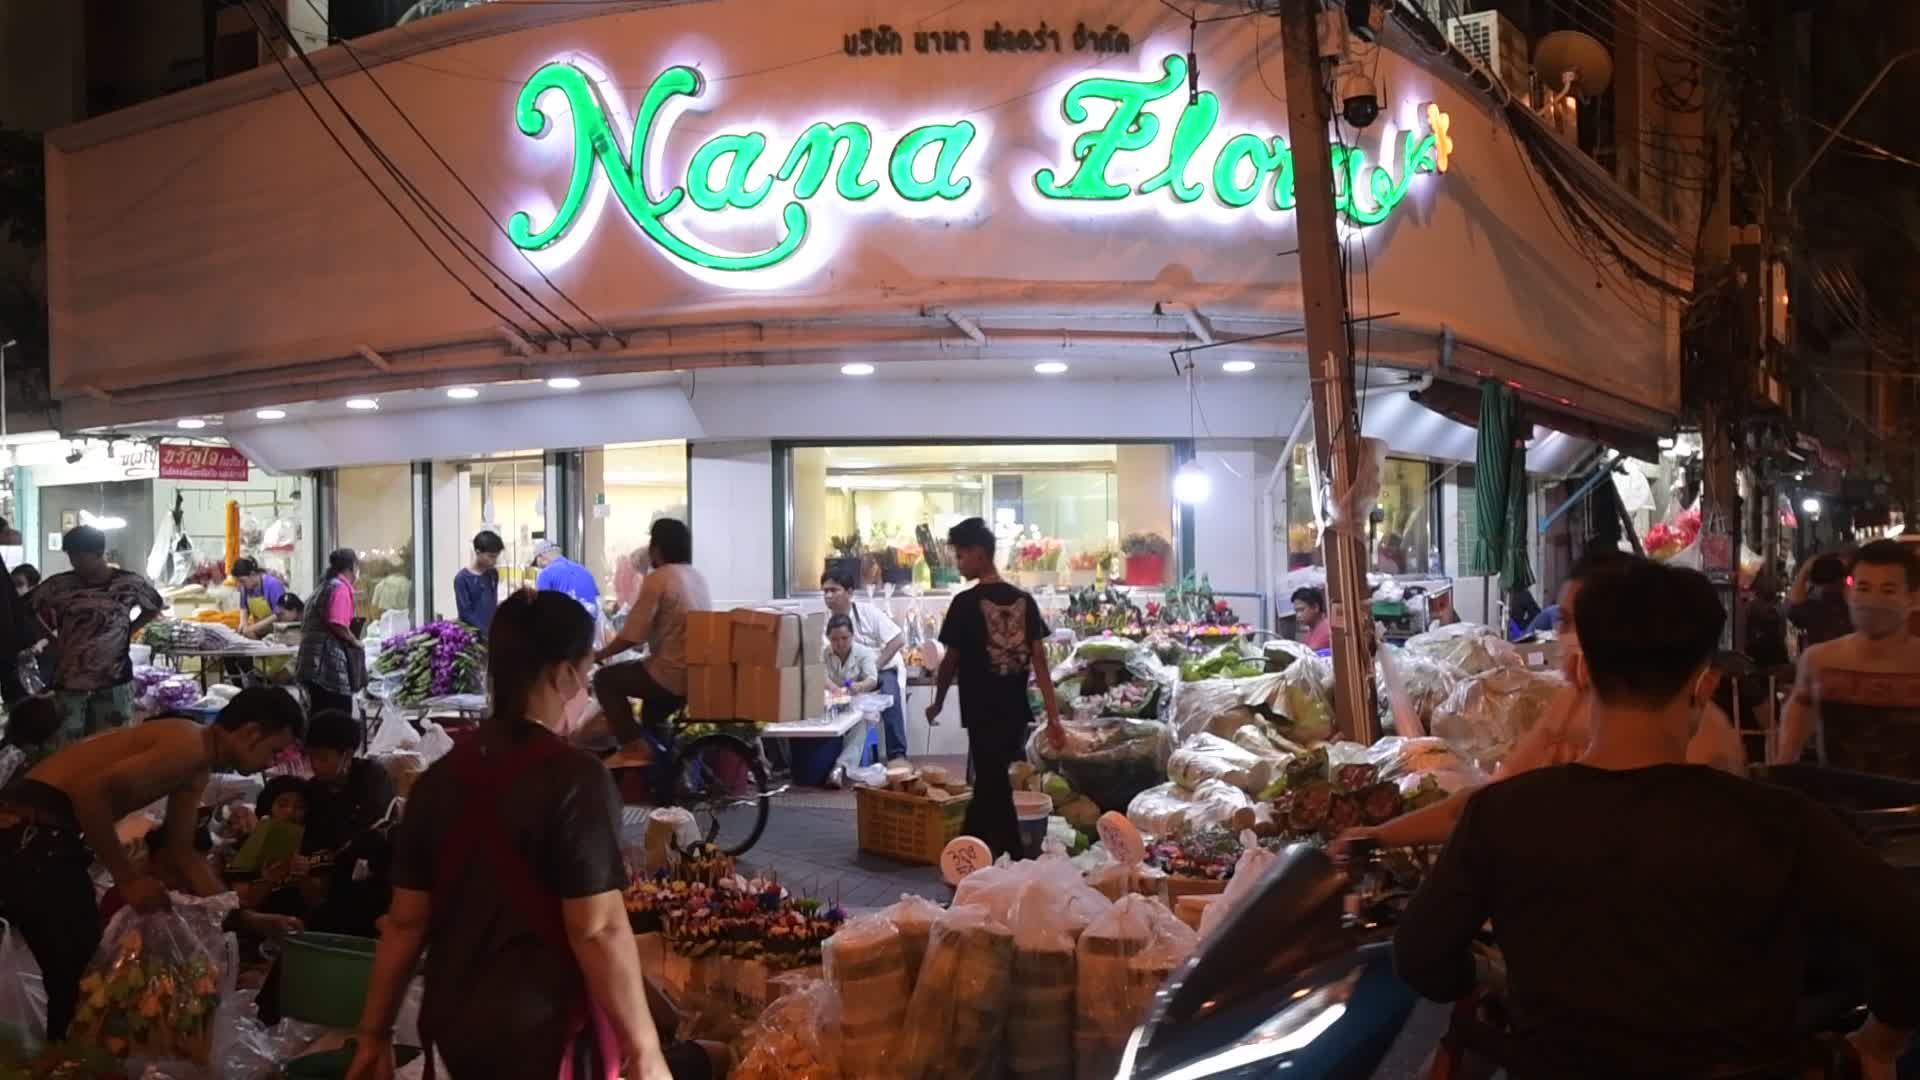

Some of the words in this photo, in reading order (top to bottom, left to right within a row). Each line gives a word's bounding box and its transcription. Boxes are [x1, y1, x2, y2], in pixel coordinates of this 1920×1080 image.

[843, 24, 903, 56] บริษัท
[914, 29, 971, 54] นานา
[1073, 21, 1130, 56] จำกัด
[508, 62, 977, 271] Nana
